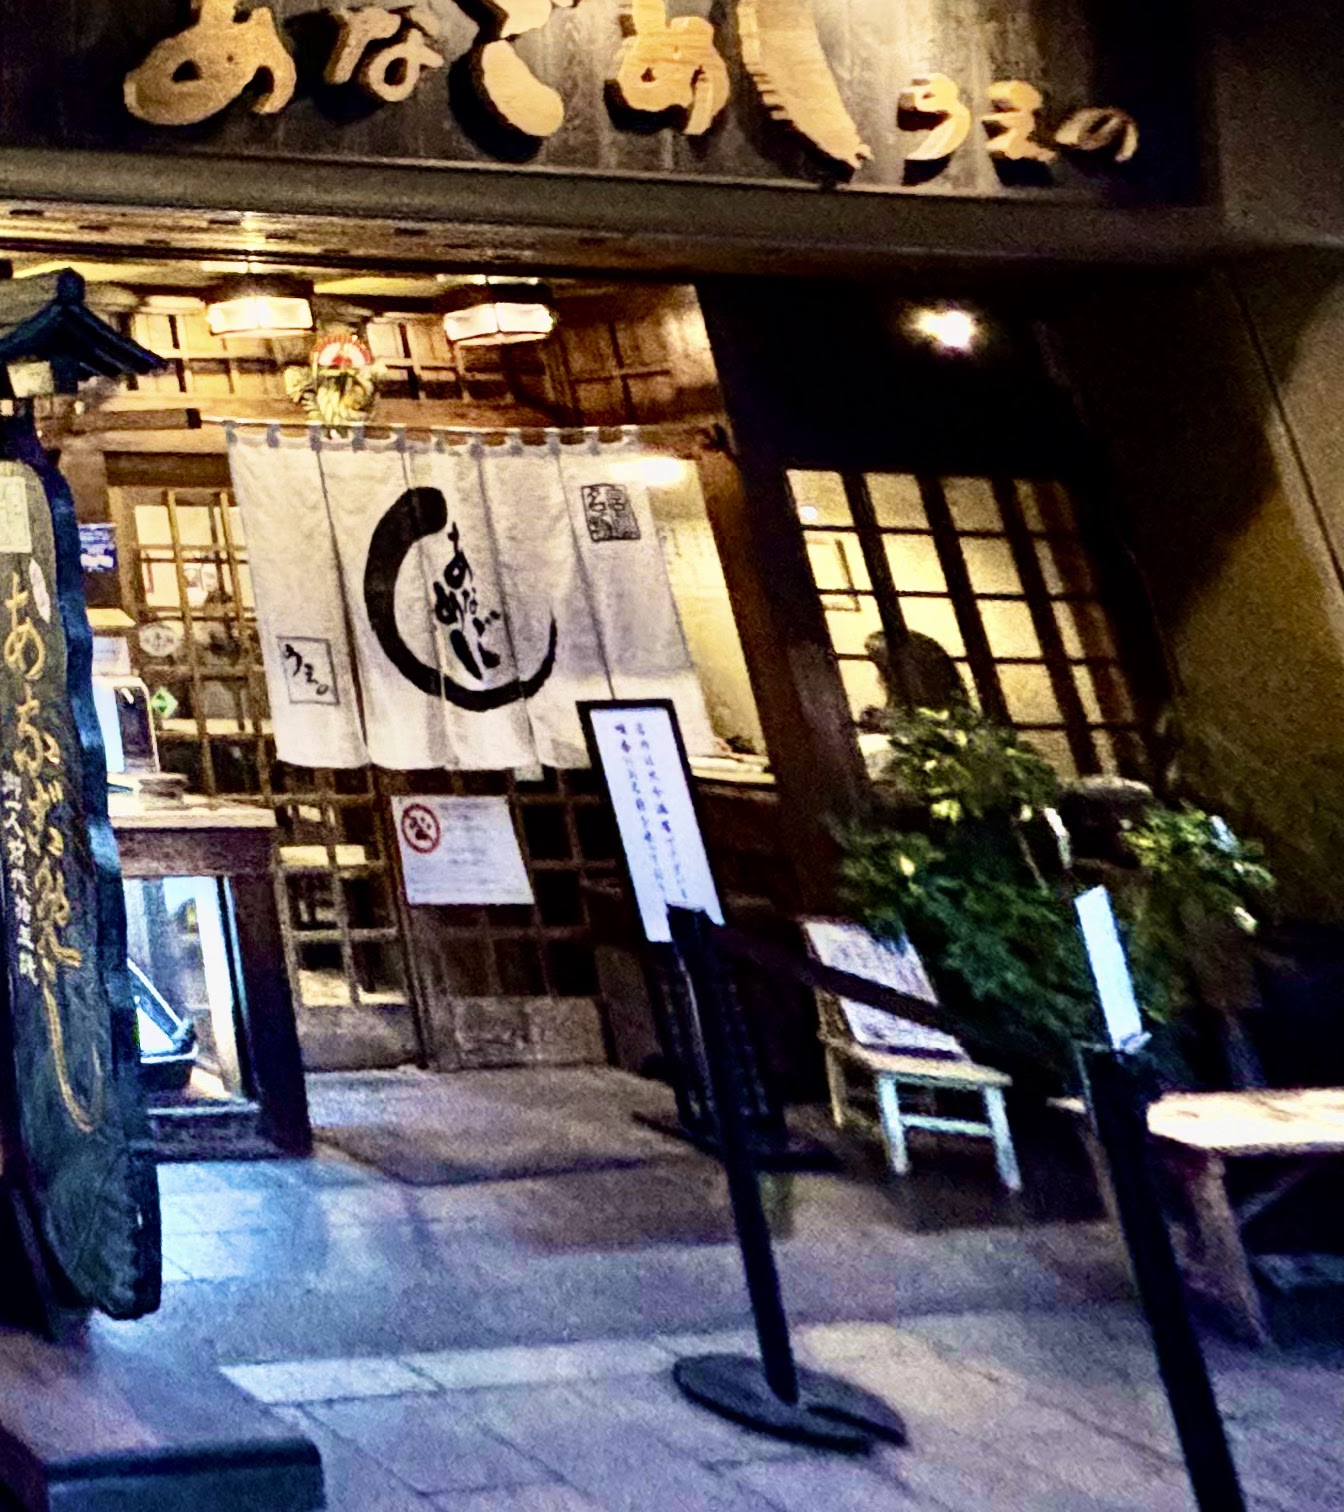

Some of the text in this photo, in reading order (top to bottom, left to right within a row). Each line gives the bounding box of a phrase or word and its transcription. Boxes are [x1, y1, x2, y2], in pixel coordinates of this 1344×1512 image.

[906, 71, 1140, 165] うえの
[283, 642, 330, 697] うえの
